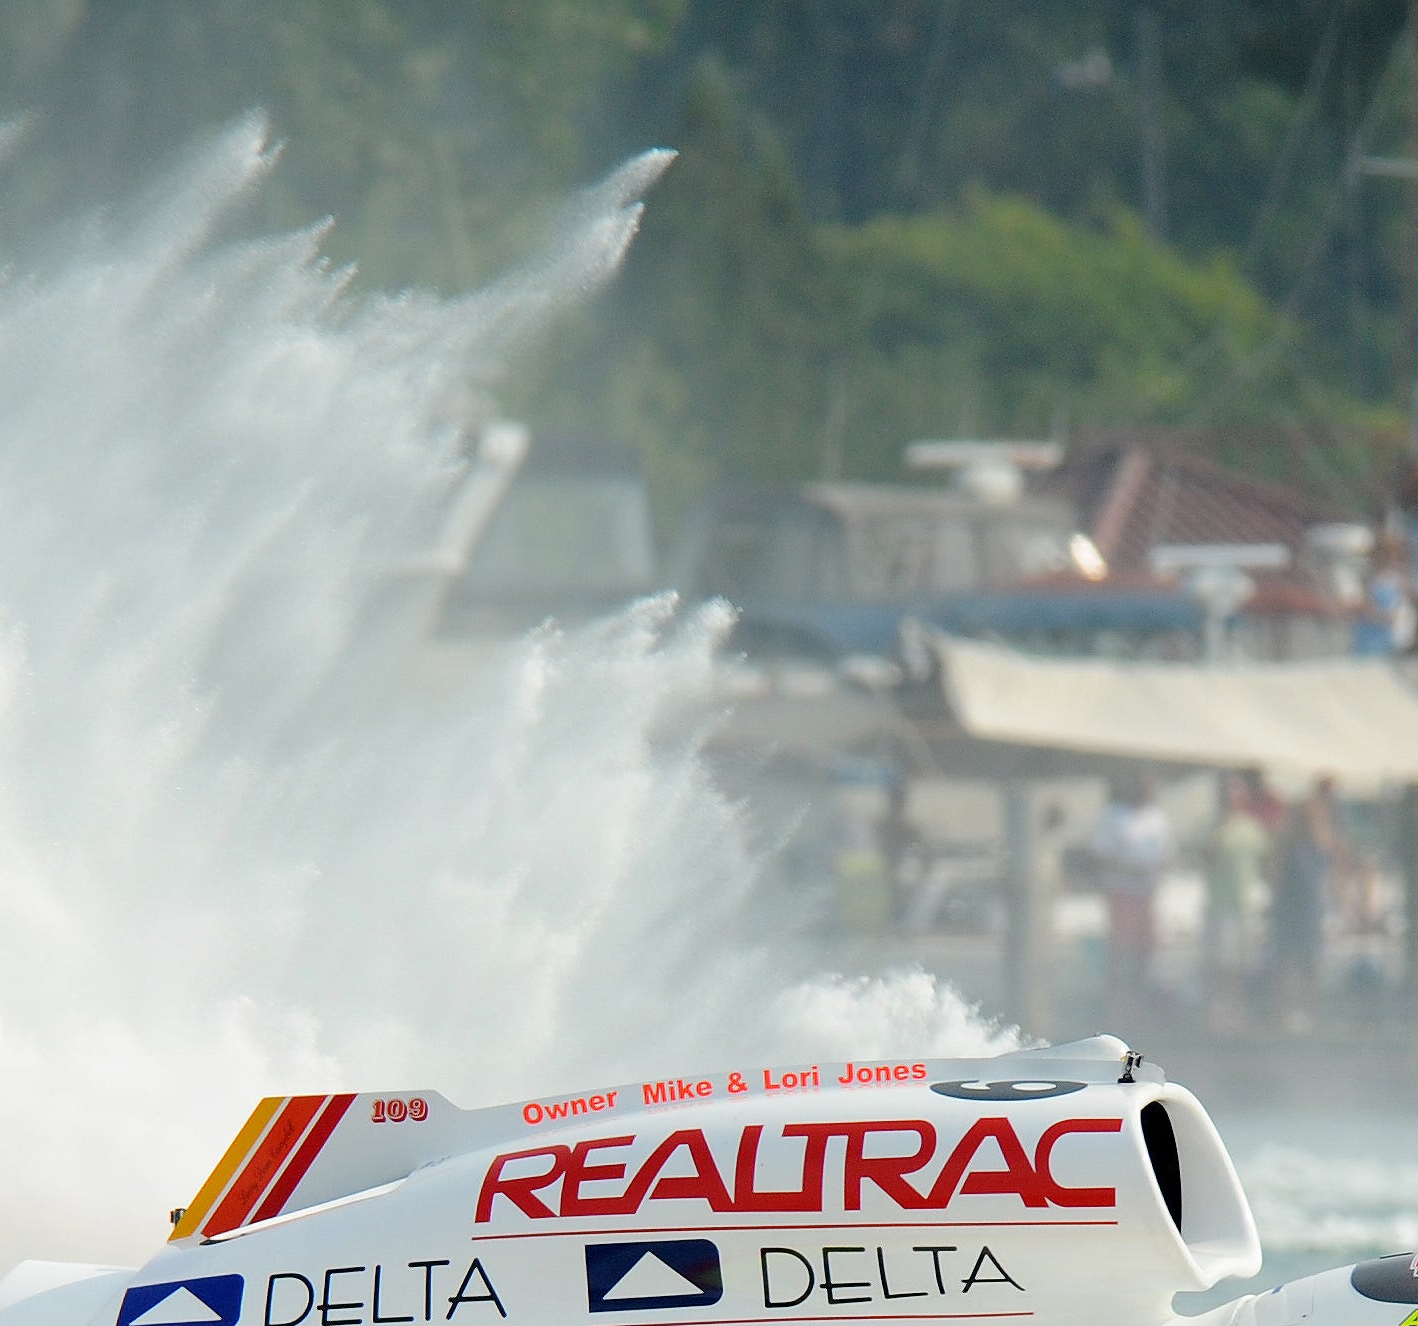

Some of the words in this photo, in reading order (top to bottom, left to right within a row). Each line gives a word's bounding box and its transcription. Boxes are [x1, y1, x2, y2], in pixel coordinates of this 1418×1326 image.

[523, 1090, 617, 1125] Owner
[643, 1080, 712, 1105] Mike
[728, 1072, 748, 1093] &
[764, 1066, 819, 1090] Lori
[838, 1062, 927, 1084] Jones
[475, 1117, 1123, 1223] REALTRAC
[761, 1246, 1025, 1308] DELTA
